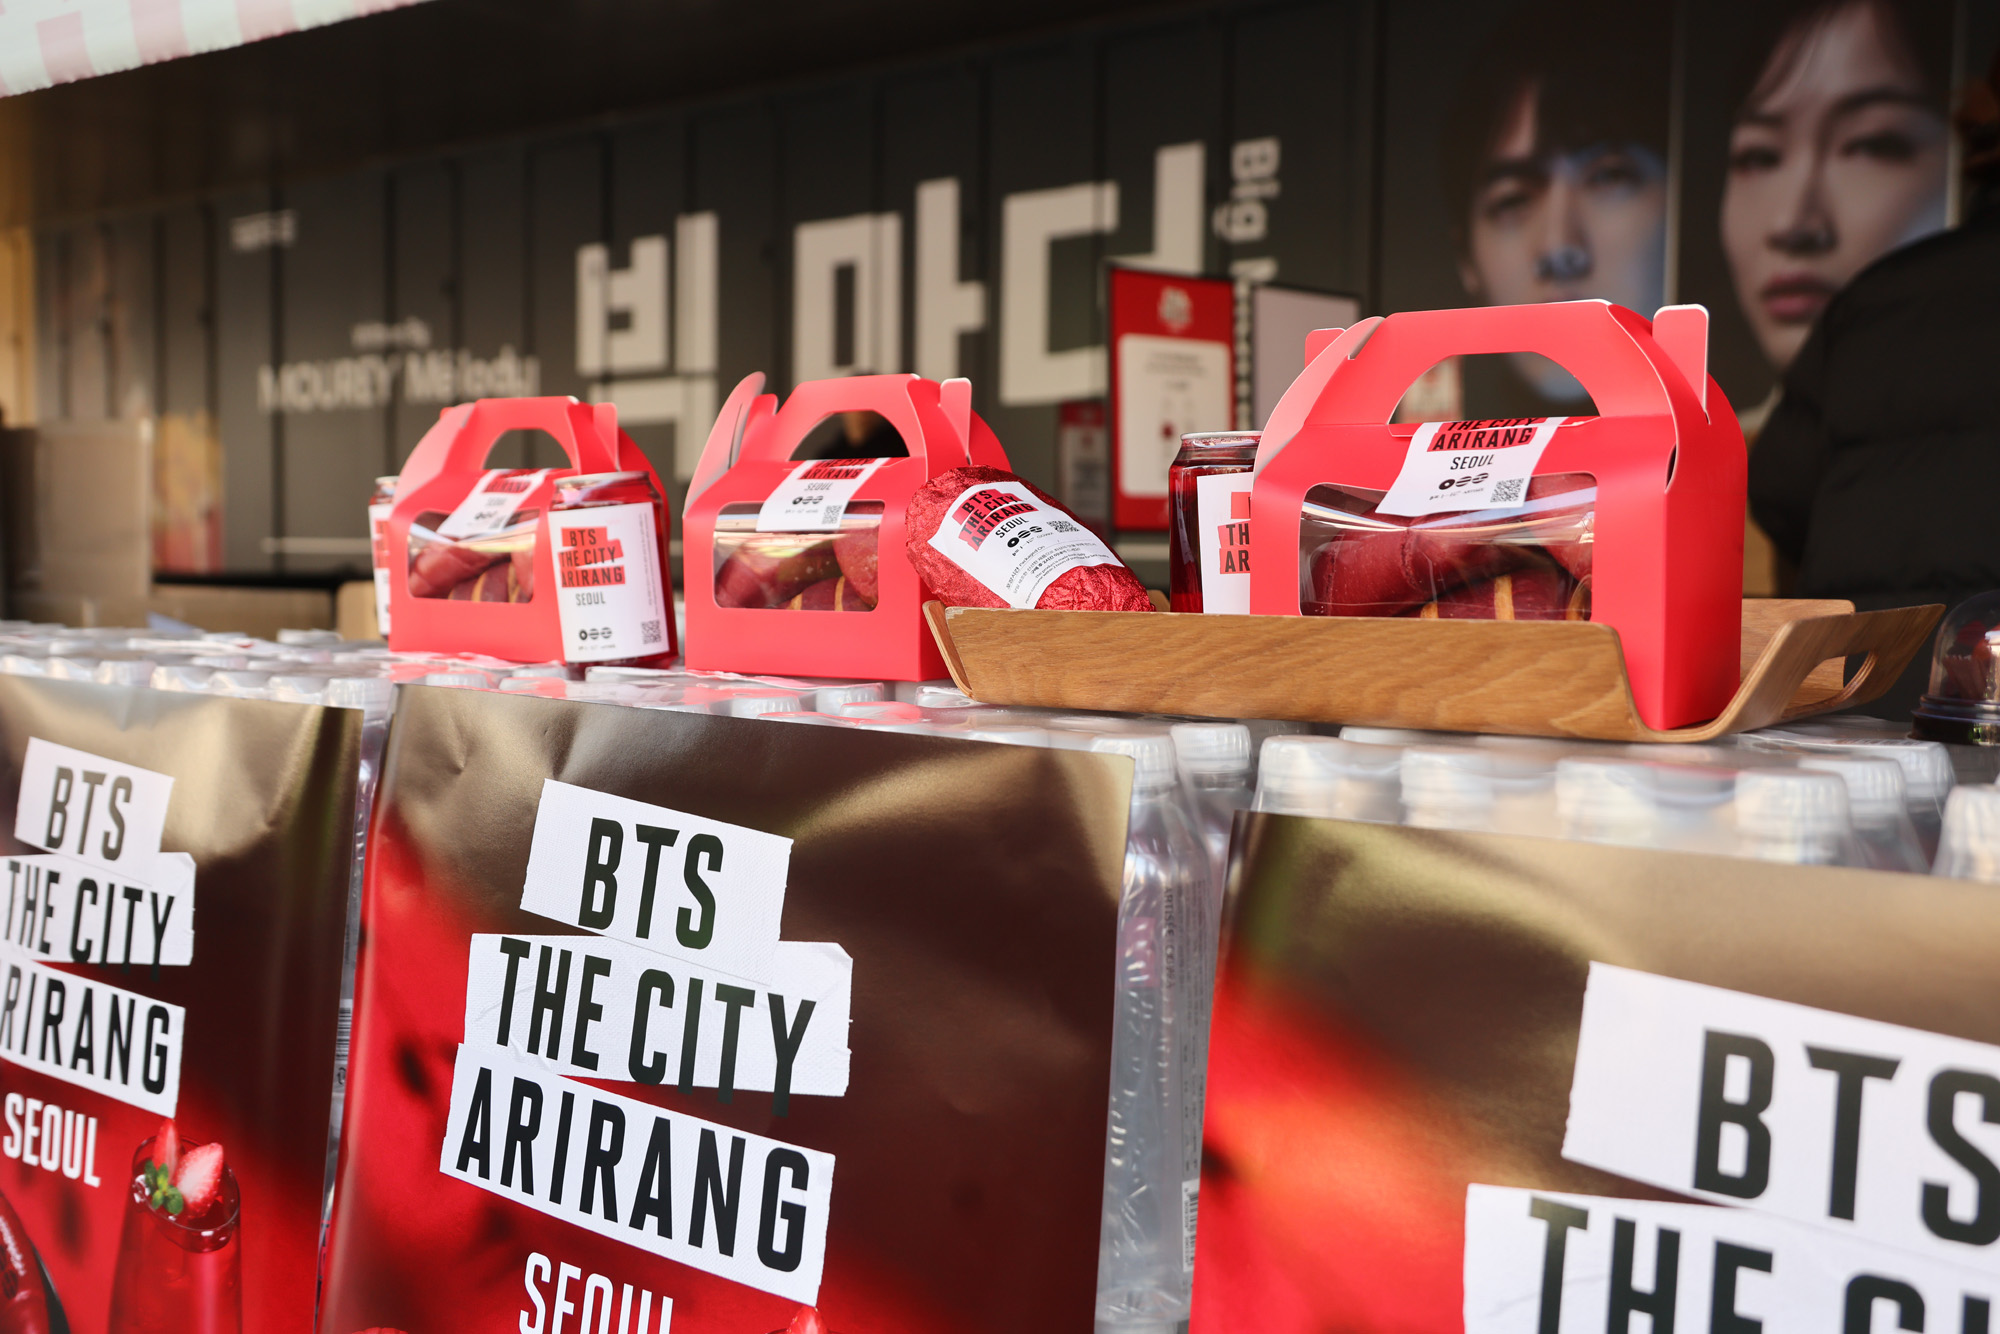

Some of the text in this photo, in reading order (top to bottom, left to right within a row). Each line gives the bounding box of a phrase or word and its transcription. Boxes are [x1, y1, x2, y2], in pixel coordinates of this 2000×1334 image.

[1213, 137, 1280, 243] Big
[576, 211, 718, 484] 빅
[1432, 428, 1533, 450] ARIRANG
[802, 468, 861, 479] ARIRANG
[1450, 454, 1495, 470] SEOUL
[804, 482, 834, 491] SEOUL
[961, 490, 992, 513] BTS
[961, 495, 1018, 535] THE CITY
[971, 503, 1035, 546] ARIRANG
[995, 517, 1029, 538] SEOUL
[1225, 523, 1250, 546] TH
[560, 546, 616, 567] THE CITY
[569, 528, 596, 547] BTS
[562, 566, 623, 587] ARIRANG
[1225, 550, 1250, 572] AR
[575, 592, 606, 606] SEOUL
[45, 765, 133, 861] BTS
[577, 816, 725, 950] BTS
[3, 858, 176, 981] THE CITY
[0, 963, 170, 1095] RIRANG
[496, 936, 818, 1118] THE CITY
[3, 1092, 101, 1188] SEOUL
[1693, 1028, 2000, 1247] BTS
[455, 1066, 811, 1274] ARIRANG
[1528, 1197, 1774, 1334] THE
